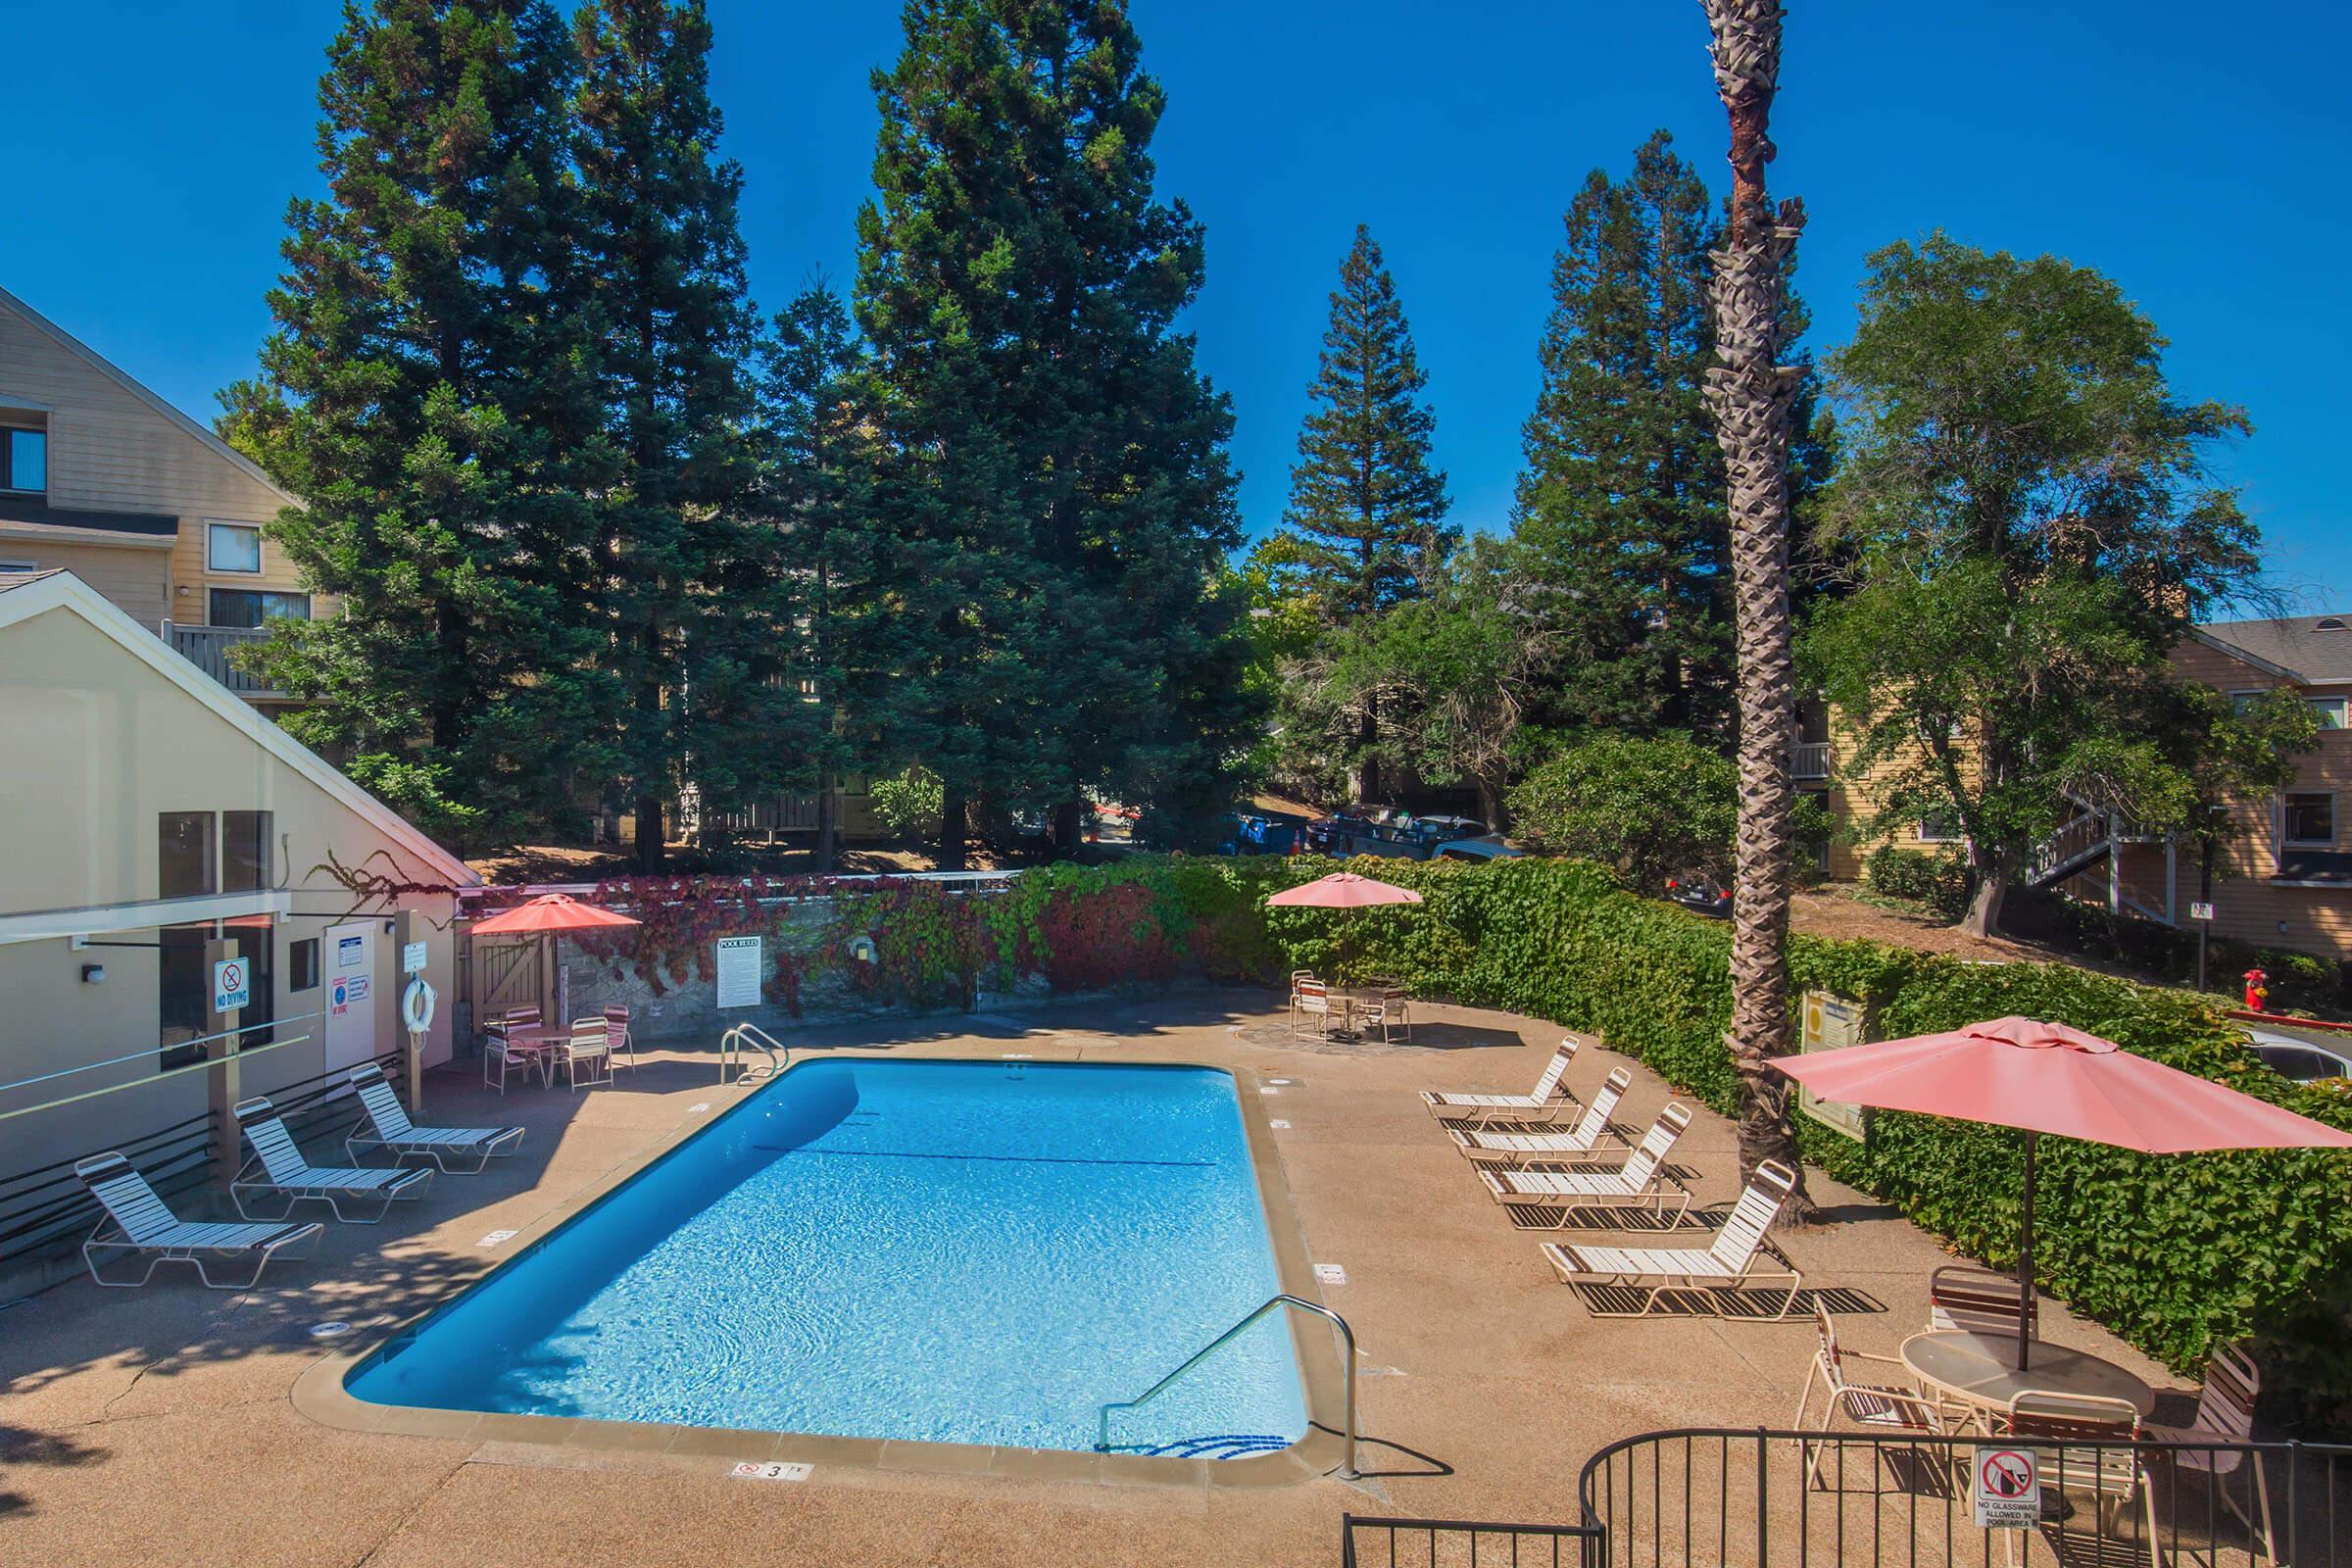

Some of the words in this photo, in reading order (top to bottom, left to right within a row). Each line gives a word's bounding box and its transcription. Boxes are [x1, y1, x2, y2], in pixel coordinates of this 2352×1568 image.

[218, 995, 226, 1007] NO
[227, 990, 247, 1005] DIVING
[767, 1465, 781, 1477] 3
[1992, 1502, 2038, 1511] GLASSWARE
[1985, 1510, 2022, 1519] ALLOWED
